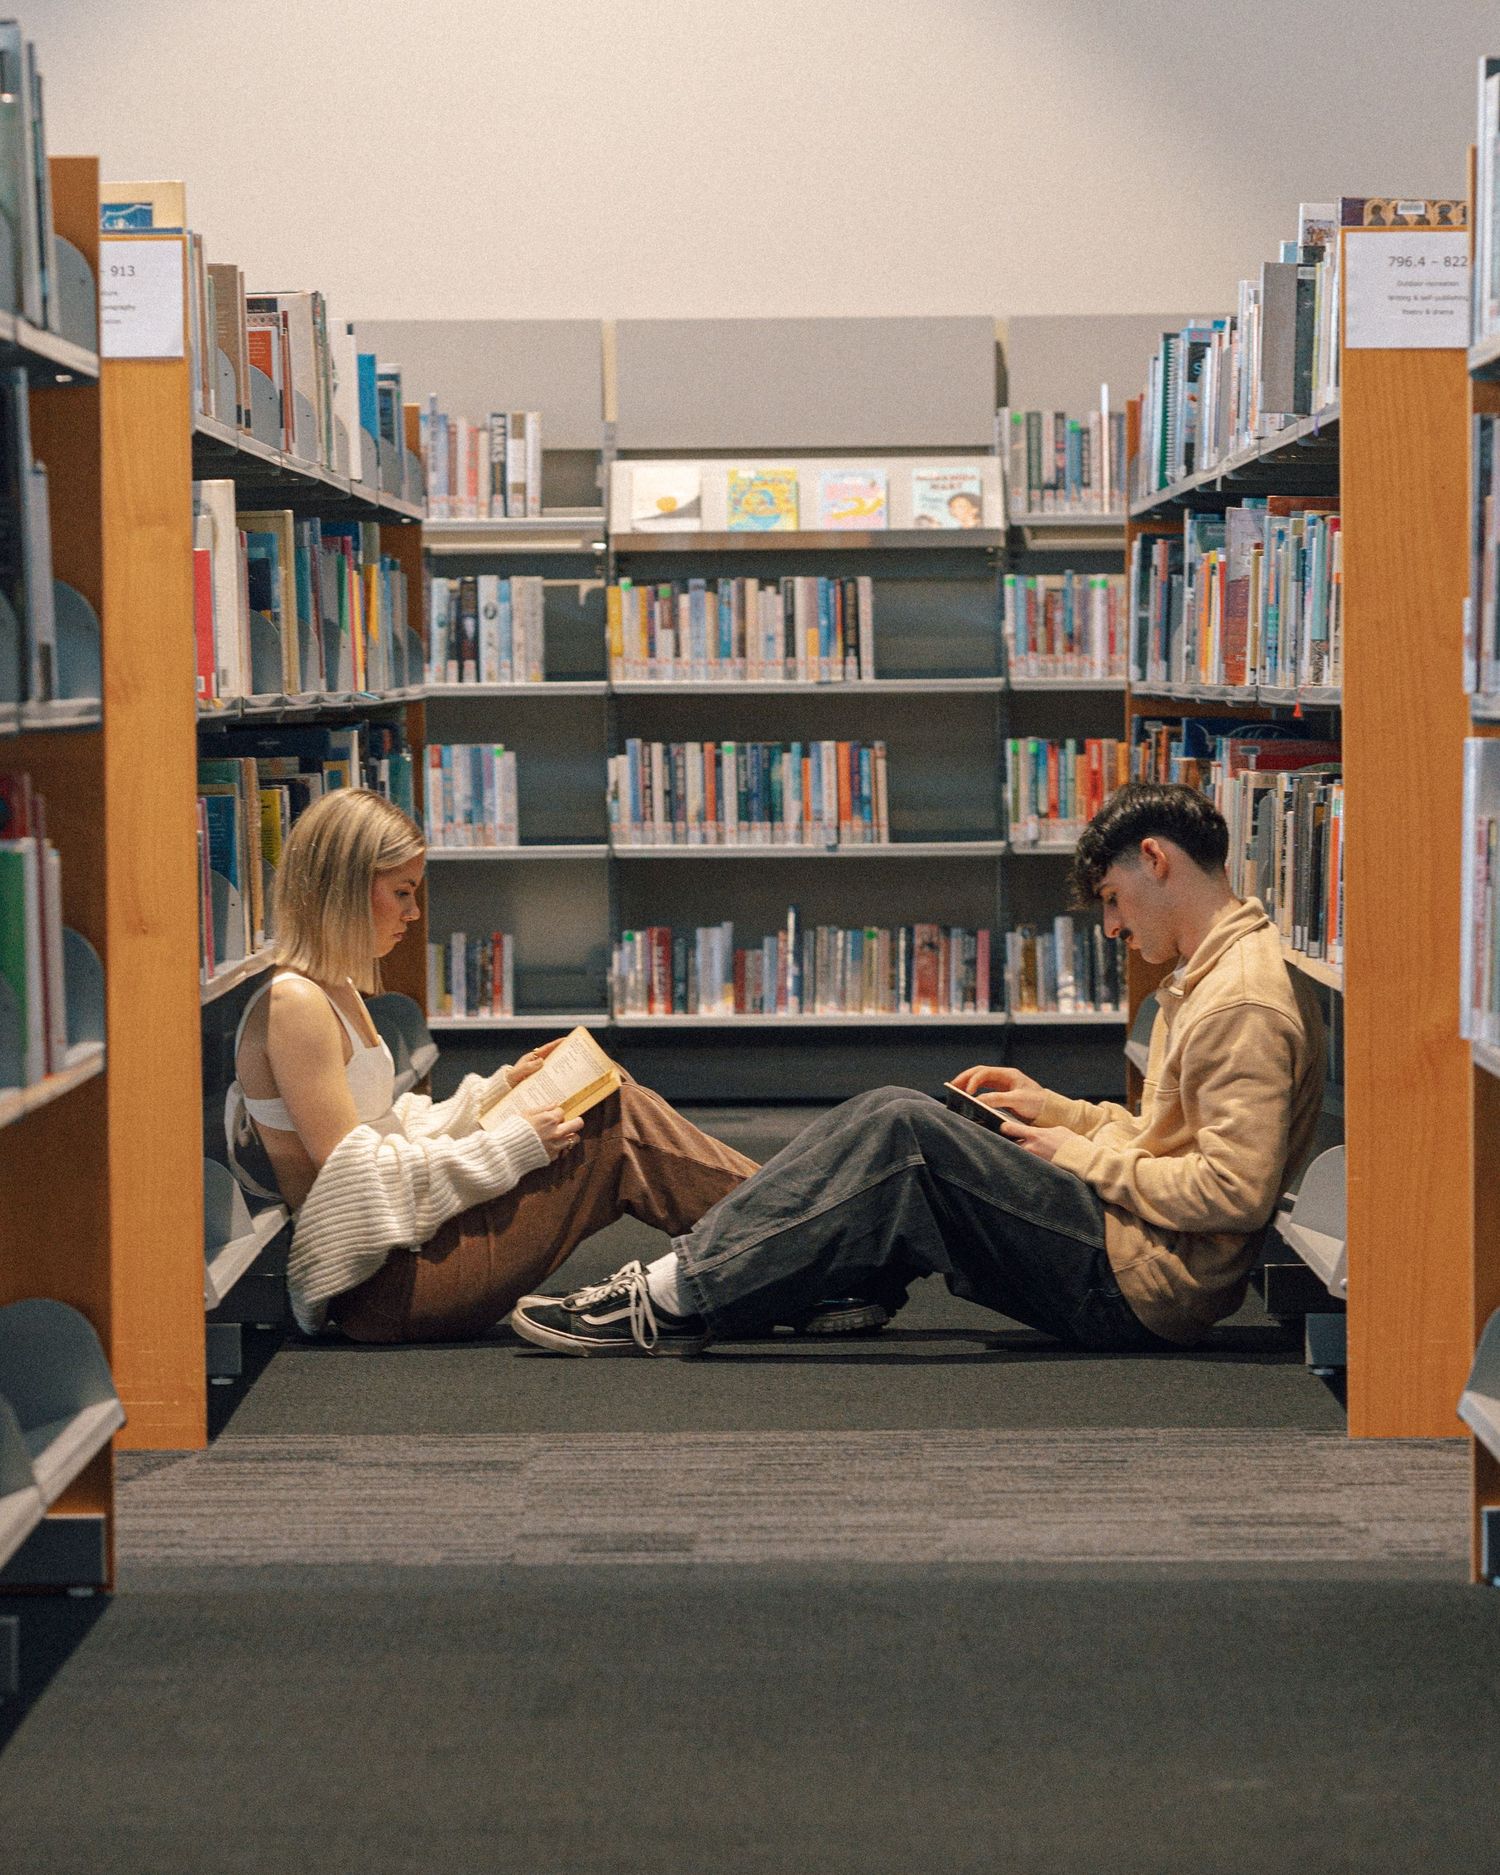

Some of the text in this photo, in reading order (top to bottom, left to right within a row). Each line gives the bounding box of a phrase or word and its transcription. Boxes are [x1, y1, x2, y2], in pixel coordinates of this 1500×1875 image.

[1388, 255, 1426, 267] 796.4
[1443, 255, 1468, 267] 822
[110, 265, 136, 277] 913
